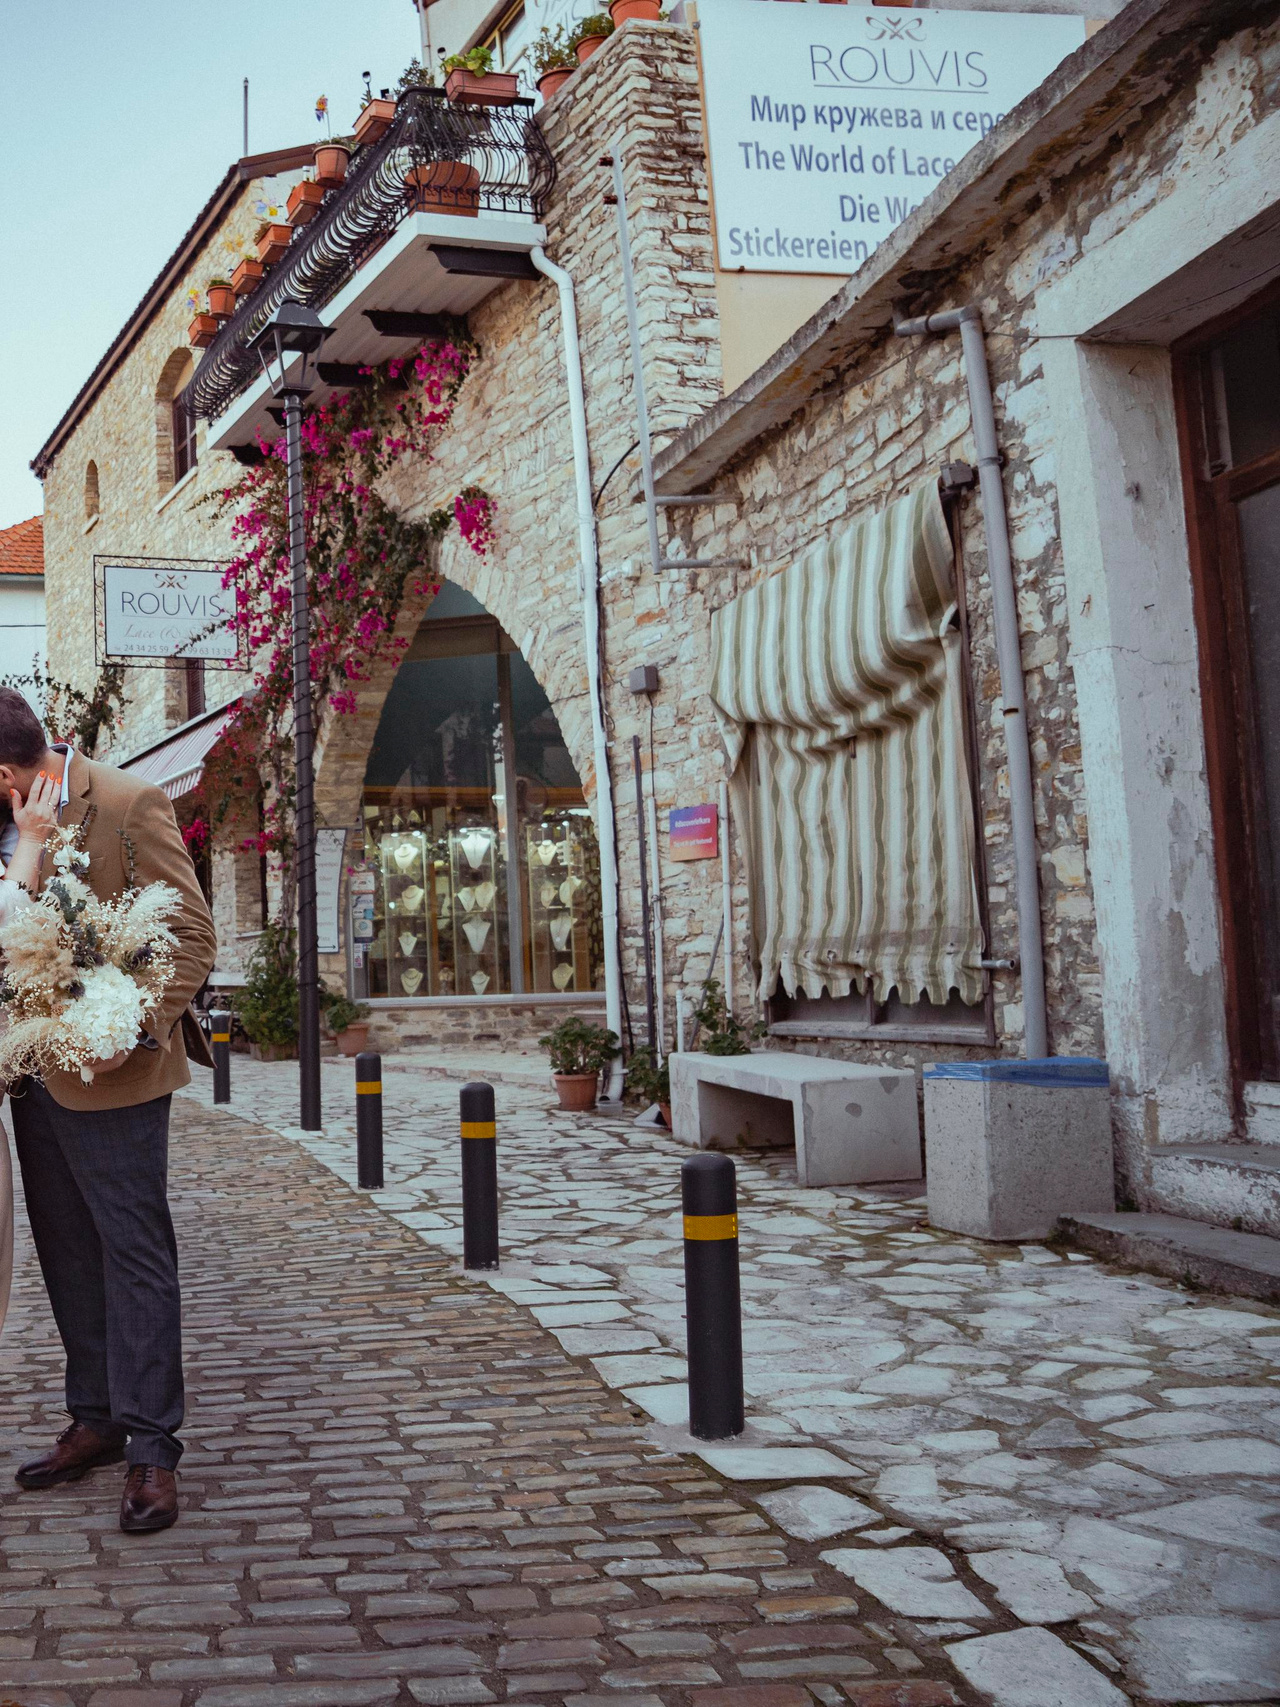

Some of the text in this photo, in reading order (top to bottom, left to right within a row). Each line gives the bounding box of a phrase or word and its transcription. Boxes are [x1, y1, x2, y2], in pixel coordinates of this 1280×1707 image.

[810, 44, 988, 88] ROUVIS
[750, 94, 807, 131] Мир
[814, 104, 923, 134] кружева
[931, 109, 946, 130] и
[738, 140, 956, 177] The World of Lace
[839, 193, 881, 224] Die
[728, 226, 868, 260] Stickereien
[121, 591, 222, 618] ROUVIS
[123, 624, 155, 639] Lace
[123, 644, 134, 652] 24
[136, 644, 145, 652] 34
[147, 645, 157, 653] 25
[159, 645, 169, 653] 59
